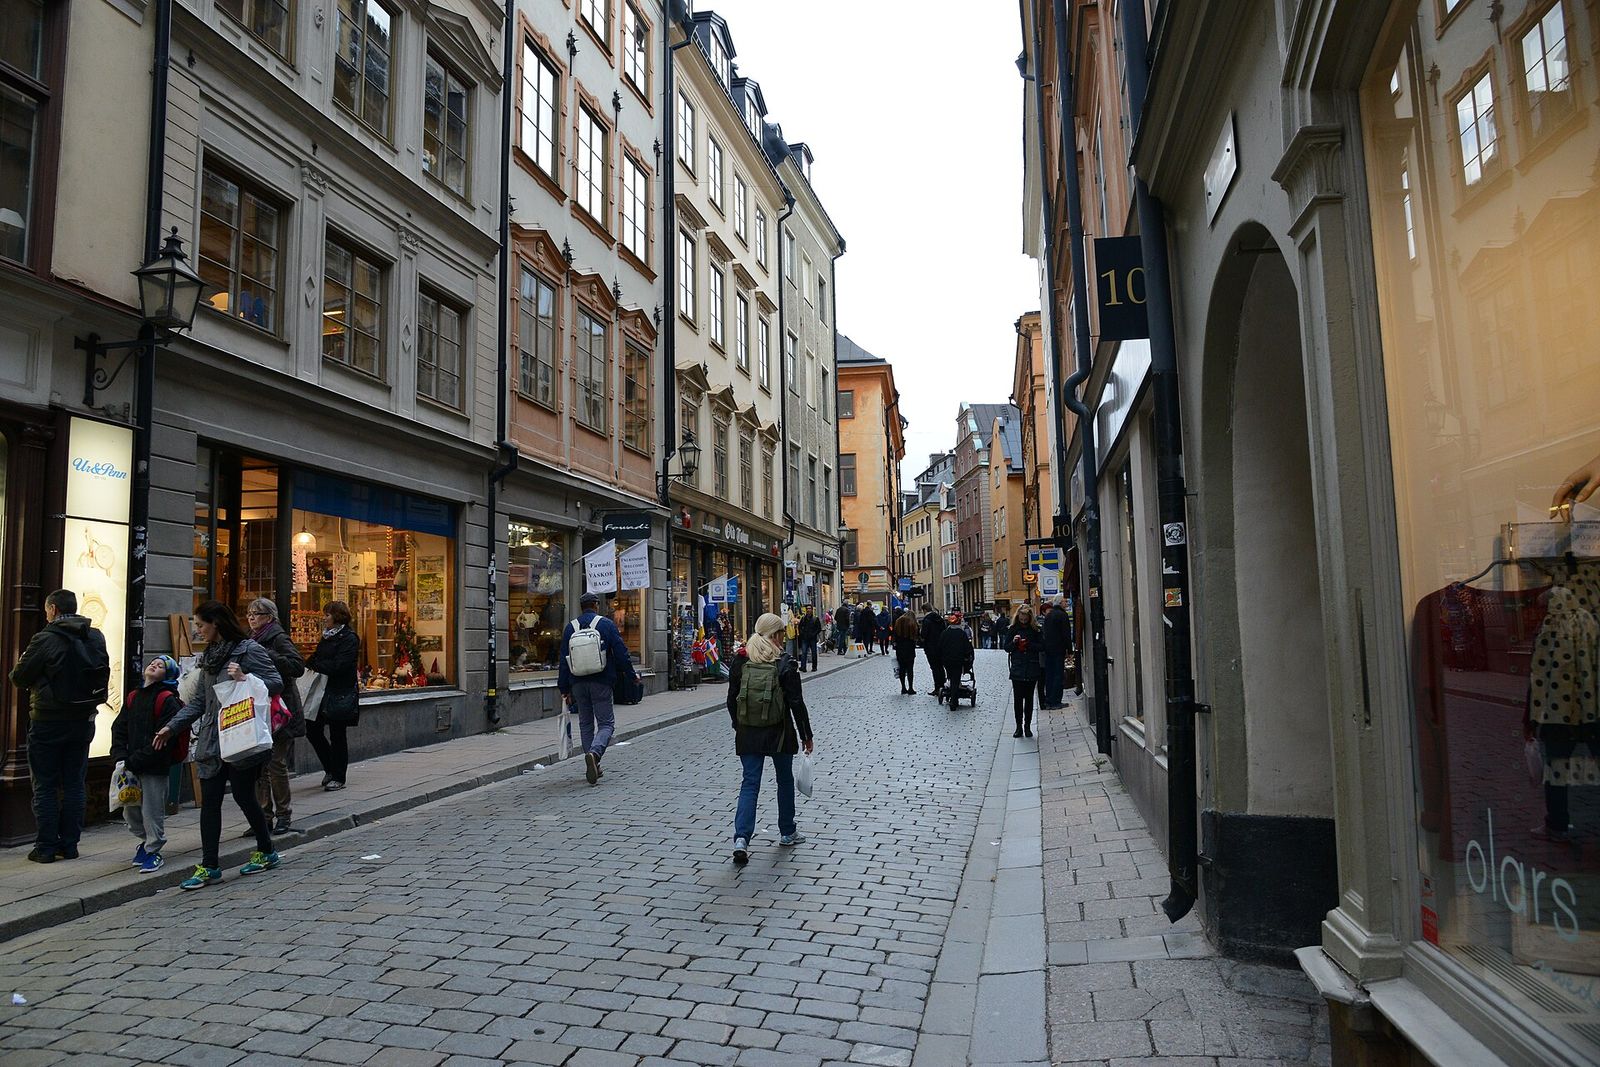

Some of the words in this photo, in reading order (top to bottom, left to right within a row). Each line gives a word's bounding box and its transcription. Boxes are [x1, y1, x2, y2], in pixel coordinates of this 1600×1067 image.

[1101, 267, 1147, 306] 10
[72, 457, 127, 480] Ur&Penn
[1055, 524, 1070, 537] 10
[1466, 807, 1579, 942] olars
